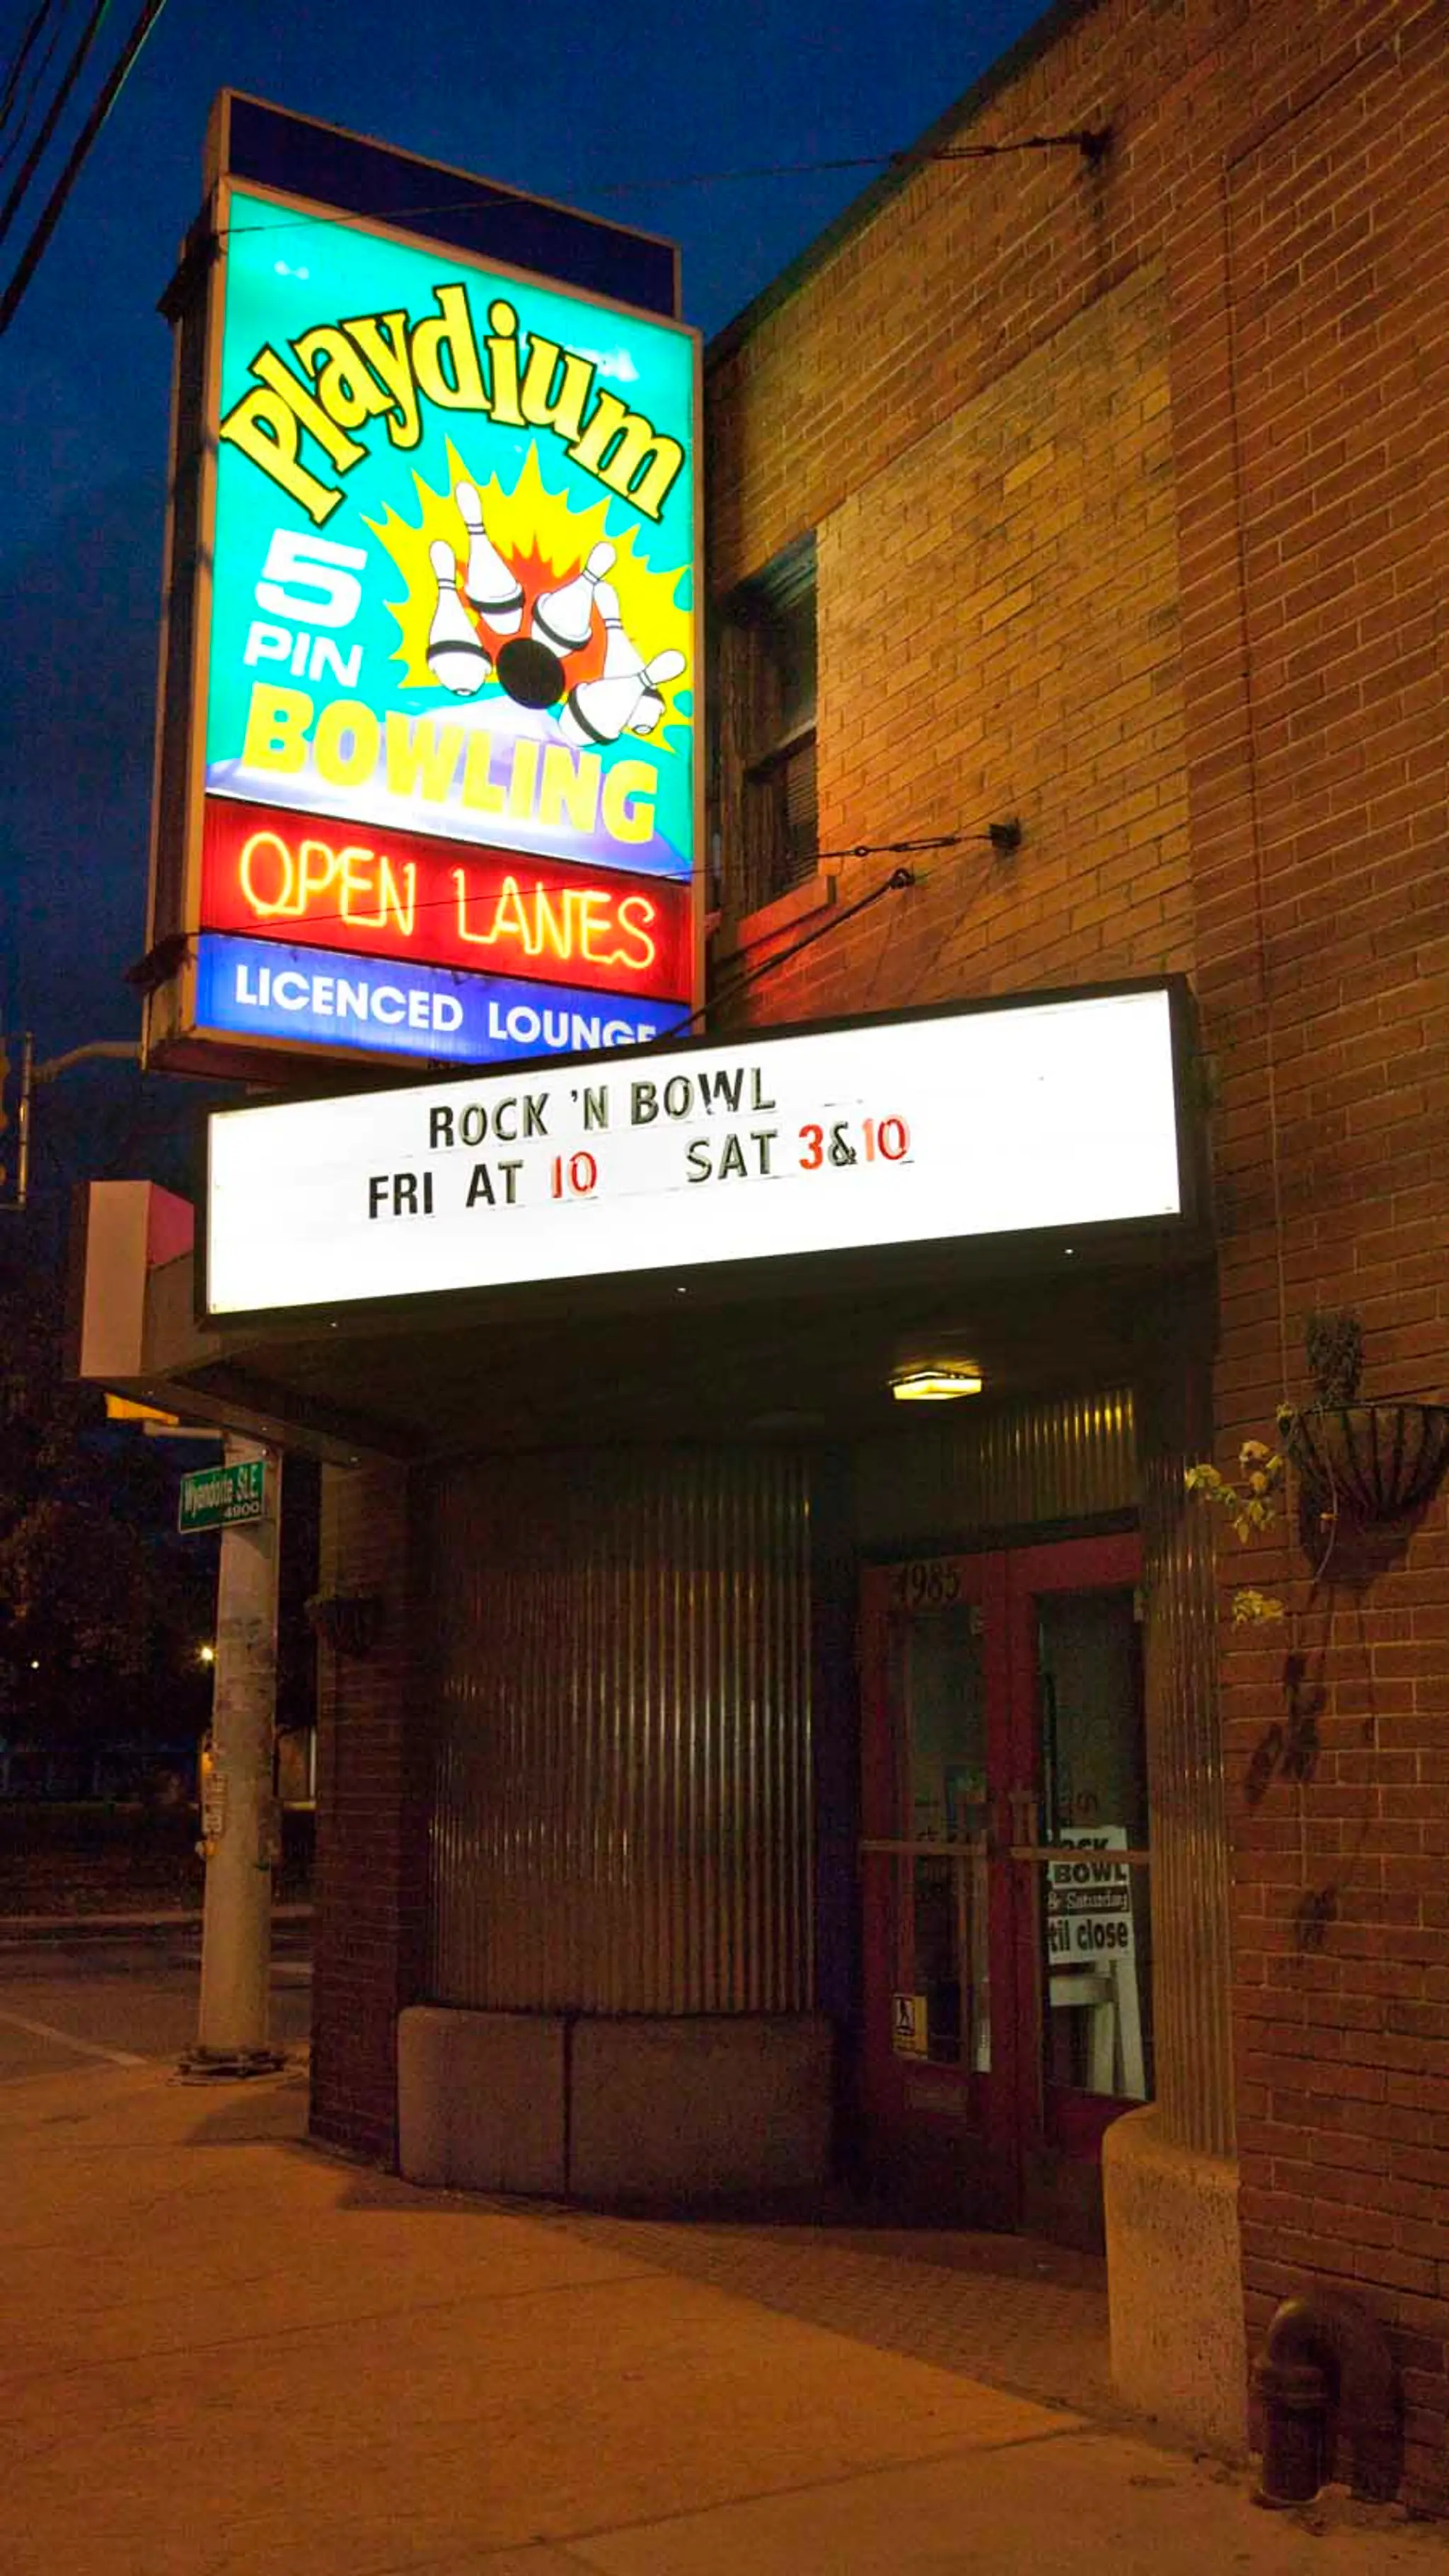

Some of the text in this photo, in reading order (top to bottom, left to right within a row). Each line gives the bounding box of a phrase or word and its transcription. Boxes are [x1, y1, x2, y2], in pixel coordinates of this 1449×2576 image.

[220, 283, 686, 529] Playdium
[255, 529, 368, 630] 5
[244, 628, 362, 686] PIN
[241, 683, 658, 844] BOWLING
[239, 831, 657, 969] OPEN LANES
[236, 964, 463, 1033] LICENCED
[429, 1093, 551, 1149] ROCK
[631, 1068, 776, 1126] BOWL
[369, 1173, 434, 1219] FRI
[466, 1163, 524, 1208] AT
[551, 1151, 597, 1199] 10
[686, 1130, 778, 1184] SAT
[1077, 1919, 1128, 1951] close
